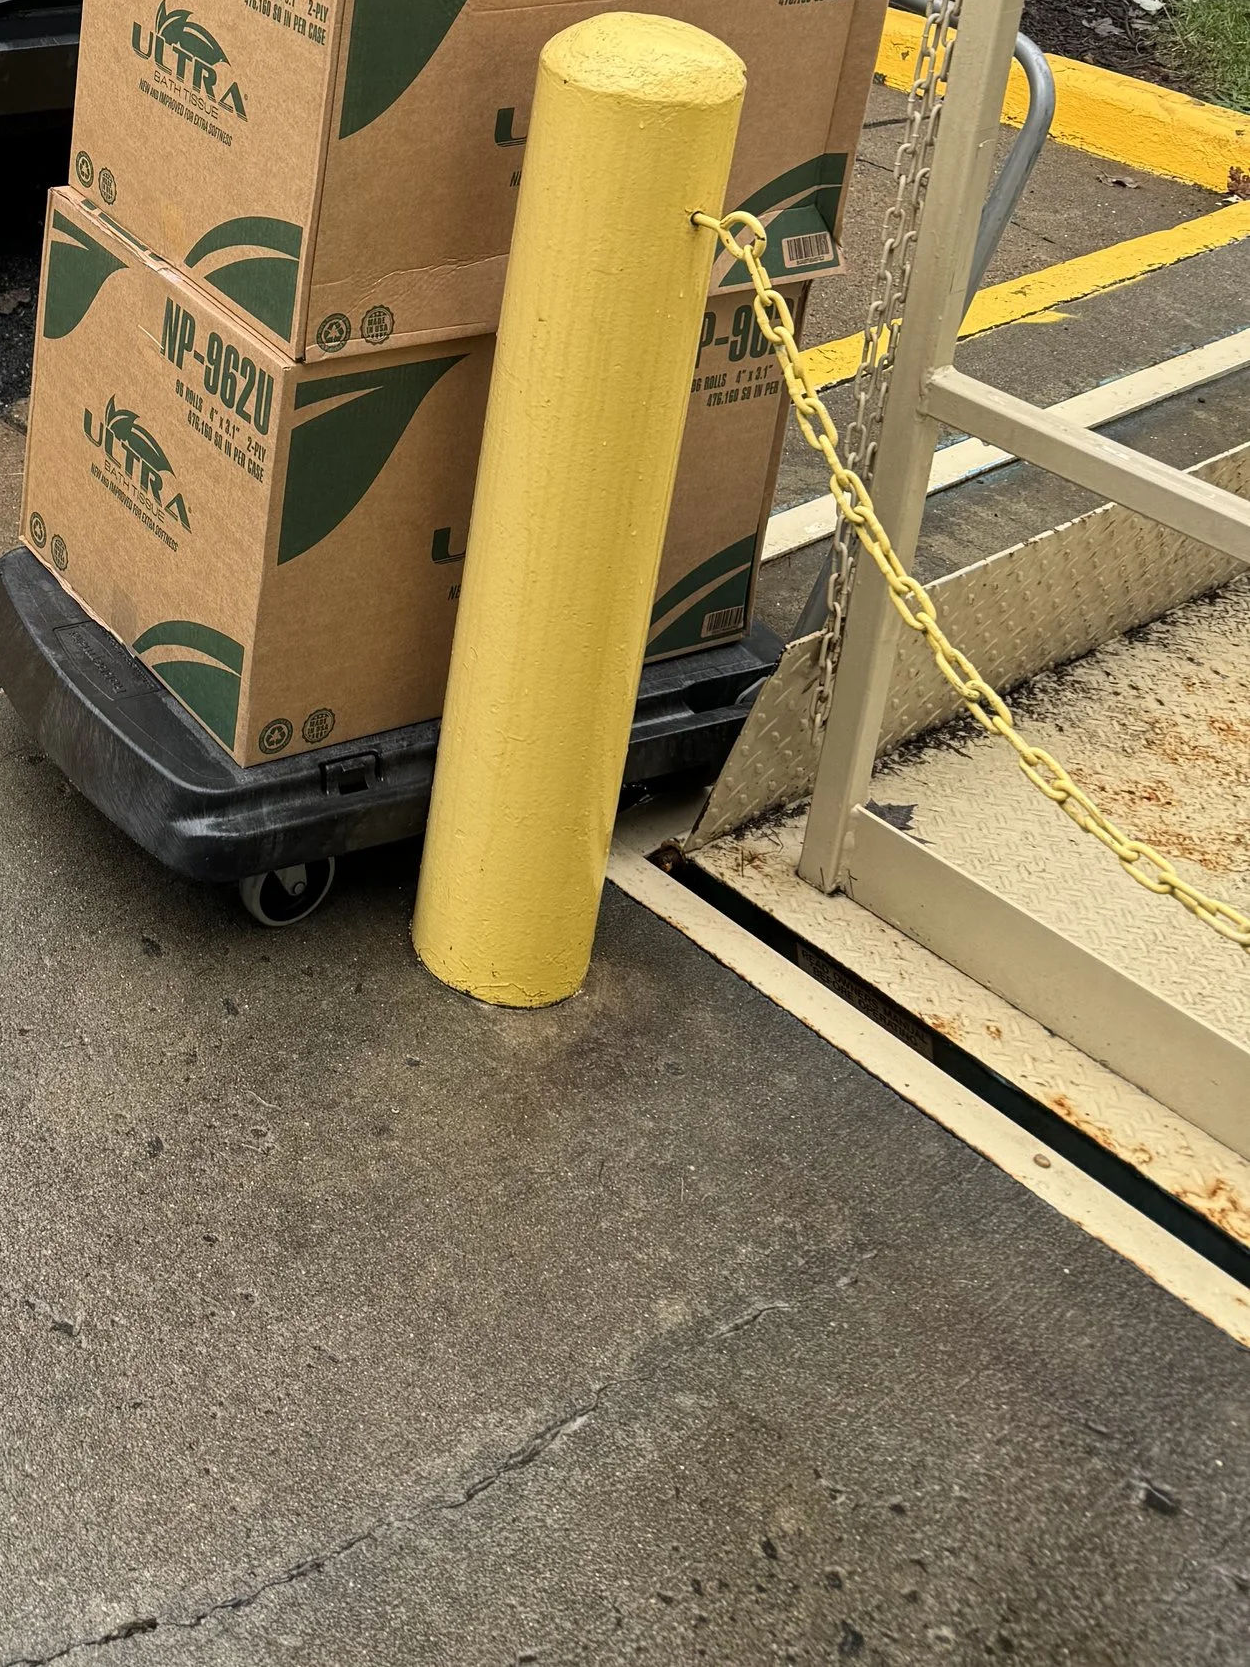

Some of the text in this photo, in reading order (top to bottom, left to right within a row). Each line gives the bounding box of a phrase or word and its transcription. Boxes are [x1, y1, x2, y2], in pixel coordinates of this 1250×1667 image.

[284, 9, 291, 28] IN
[293, 14, 306, 35] PER
[308, 22, 326, 45] CASE
[132, 22, 248, 122] ULTRA
[154, 70, 218, 119] BATH TISSUE
[161, 297, 274, 438] NP-962U
[704, 373, 727, 390] ROLLS
[754, 383, 762, 398] IN
[765, 381, 779, 396] PER
[84, 408, 192, 534] ULTRA
[105, 459, 165, 523] BATH TISSUE
